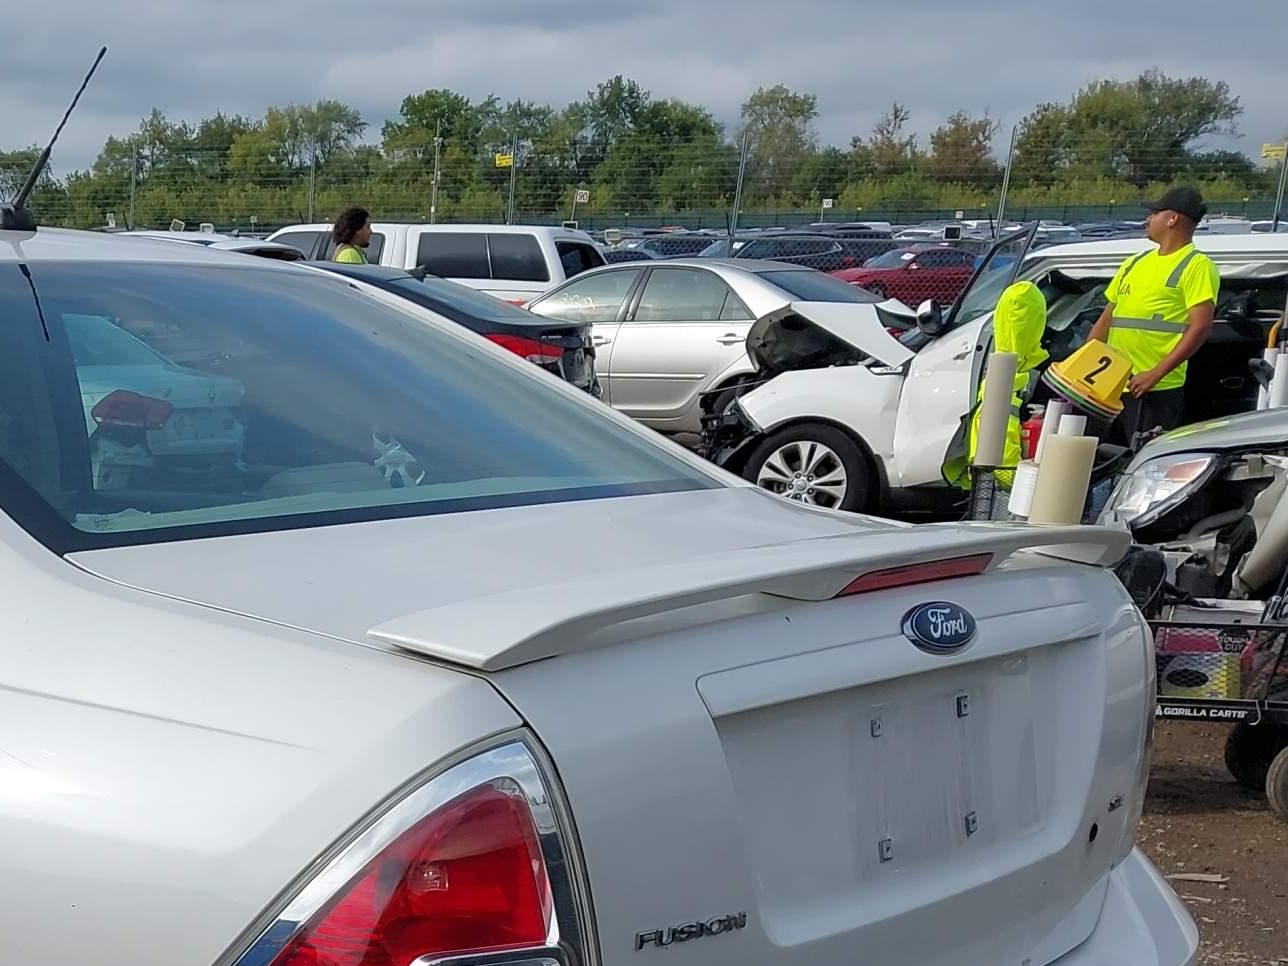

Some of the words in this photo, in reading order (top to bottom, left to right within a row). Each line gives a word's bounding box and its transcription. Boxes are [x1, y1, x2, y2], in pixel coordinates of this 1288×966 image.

[1083, 356, 1112, 385] 2
[928, 607, 968, 639] Ford
[1163, 707, 1207, 717] GORILLA
[1209, 709, 1245, 718] CARTS
[635, 911, 747, 951] FUSION
